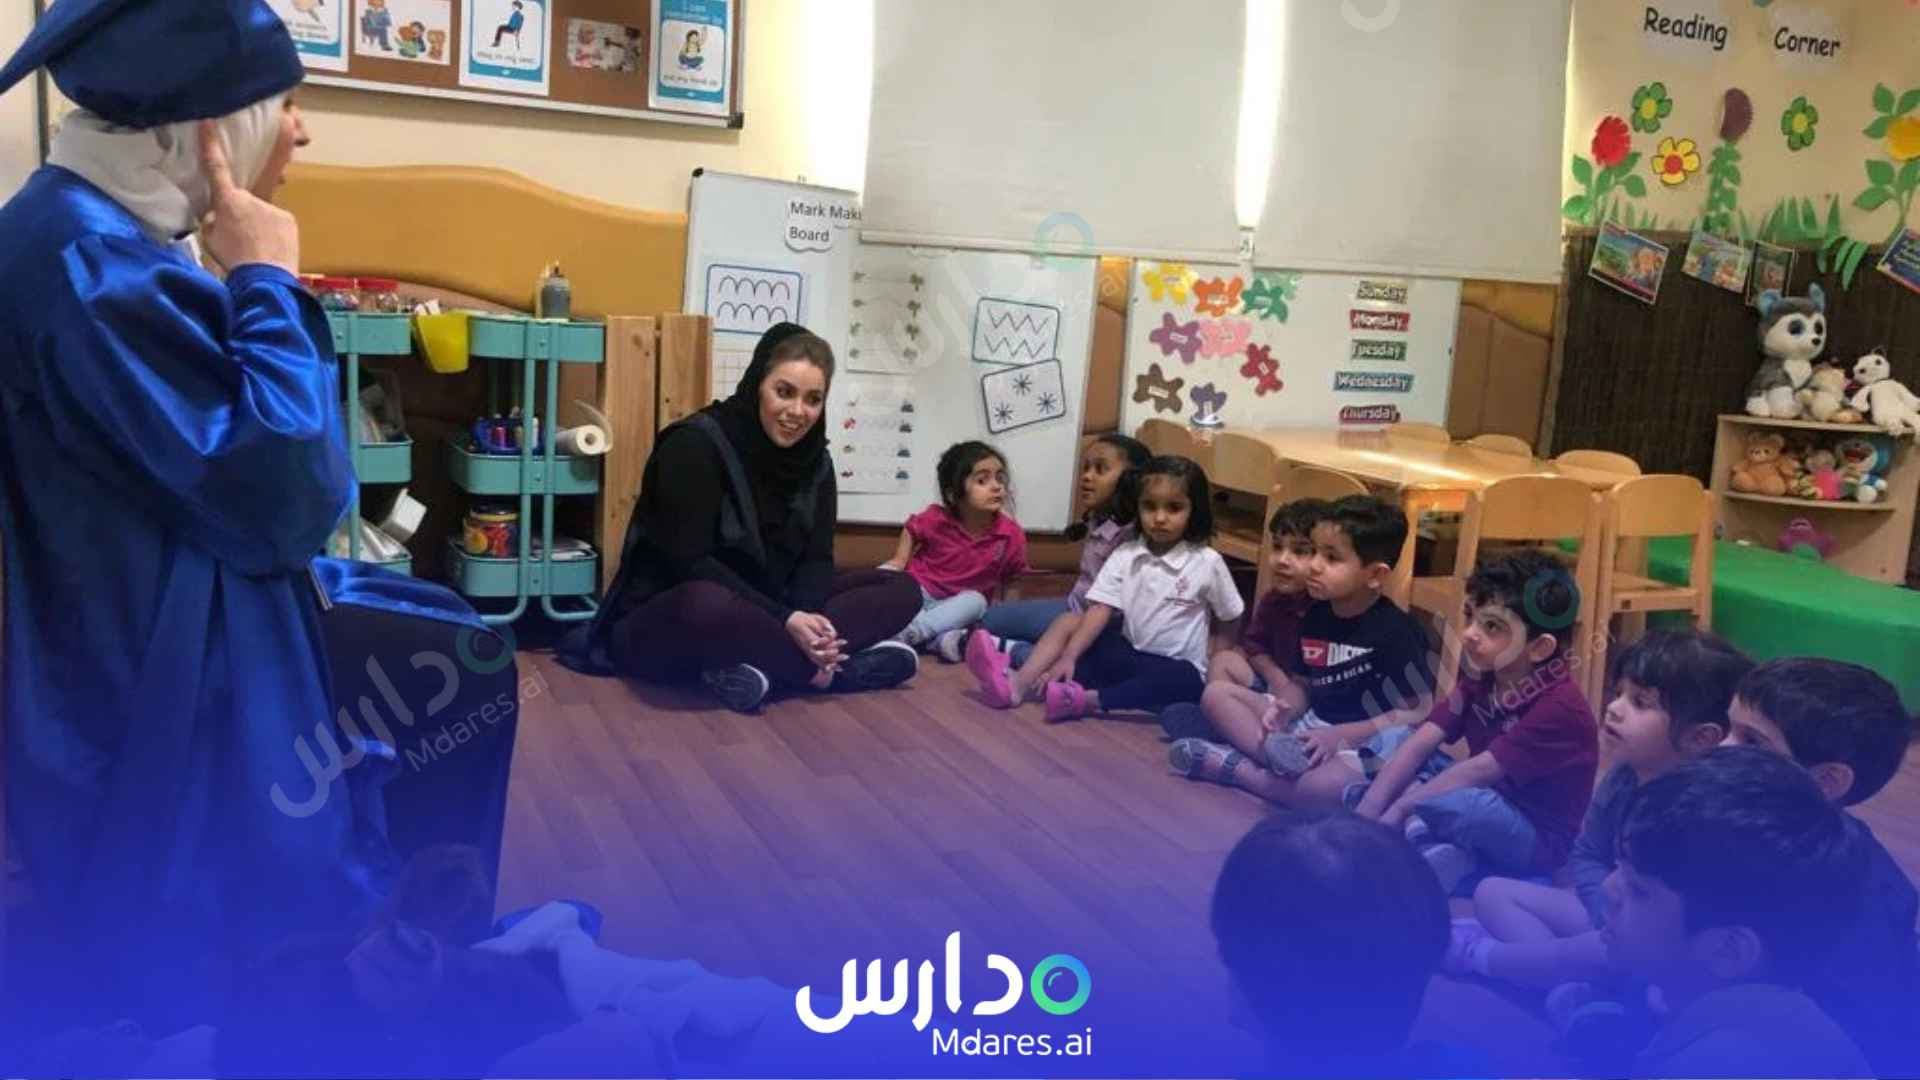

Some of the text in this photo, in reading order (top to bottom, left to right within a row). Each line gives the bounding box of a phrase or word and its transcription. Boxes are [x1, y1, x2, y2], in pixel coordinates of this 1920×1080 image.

[1644, 7, 1728, 51] Reading
[1774, 27, 1841, 57] Corner
[791, 201, 825, 217] Mark
[789, 226, 829, 241] Board
[1358, 283, 1406, 303] Sunday
[1352, 313, 1403, 331] Monday
[1352, 341, 1401, 360] Tuesday
[1336, 373, 1407, 391] Wednesday
[1343, 406, 1398, 422] Thursday
